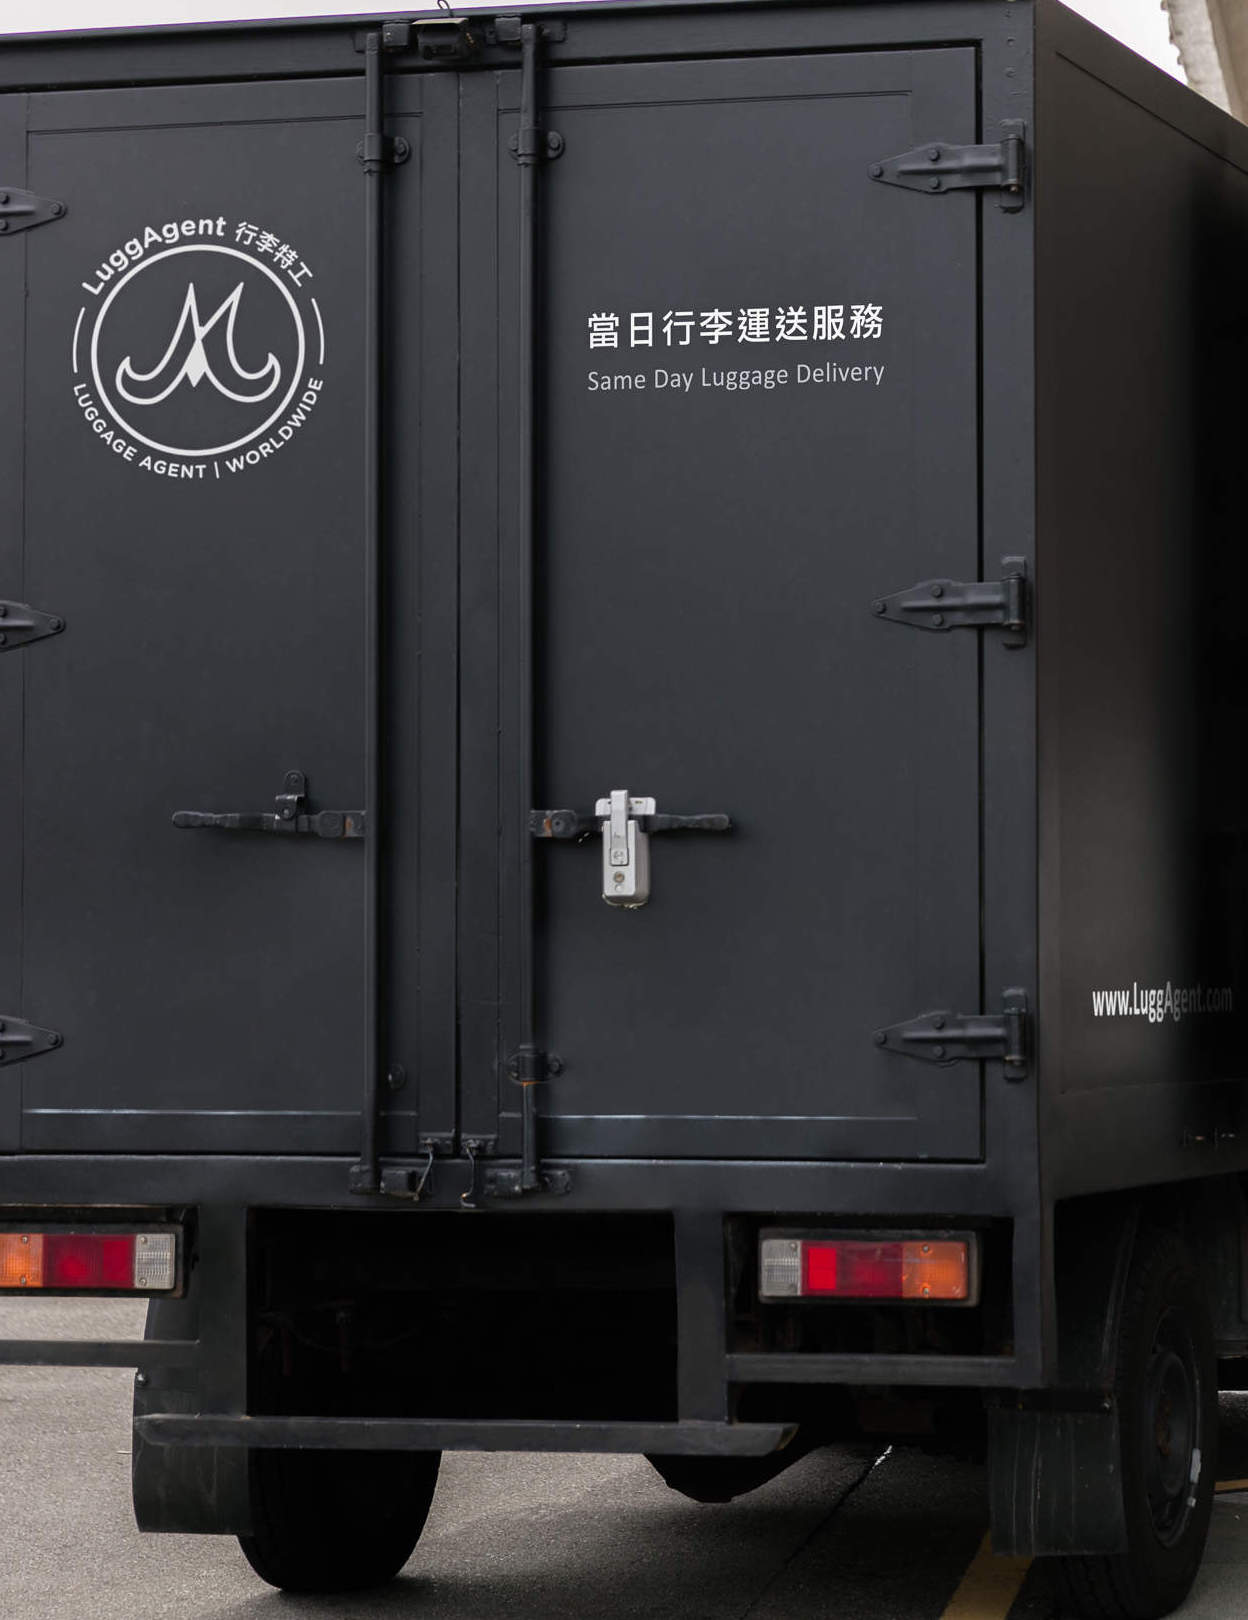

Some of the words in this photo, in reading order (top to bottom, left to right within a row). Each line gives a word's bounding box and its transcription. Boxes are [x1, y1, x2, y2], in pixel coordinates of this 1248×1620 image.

[82, 216, 227, 296] LuggAgent
[234, 221, 313, 288] 行李特工
[587, 303, 884, 348] 當日行李運送服務
[587, 371, 646, 391] Same
[654, 368, 694, 392] Day
[701, 366, 789, 390] Luggage
[796, 362, 885, 385] Delivery
[73, 383, 137, 463] LUGGAGE
[139, 454, 206, 479] AGENT
[225, 377, 324, 474] WORLDWIDE
[1092, 981, 1233, 1023] www.LuggAgent.com
